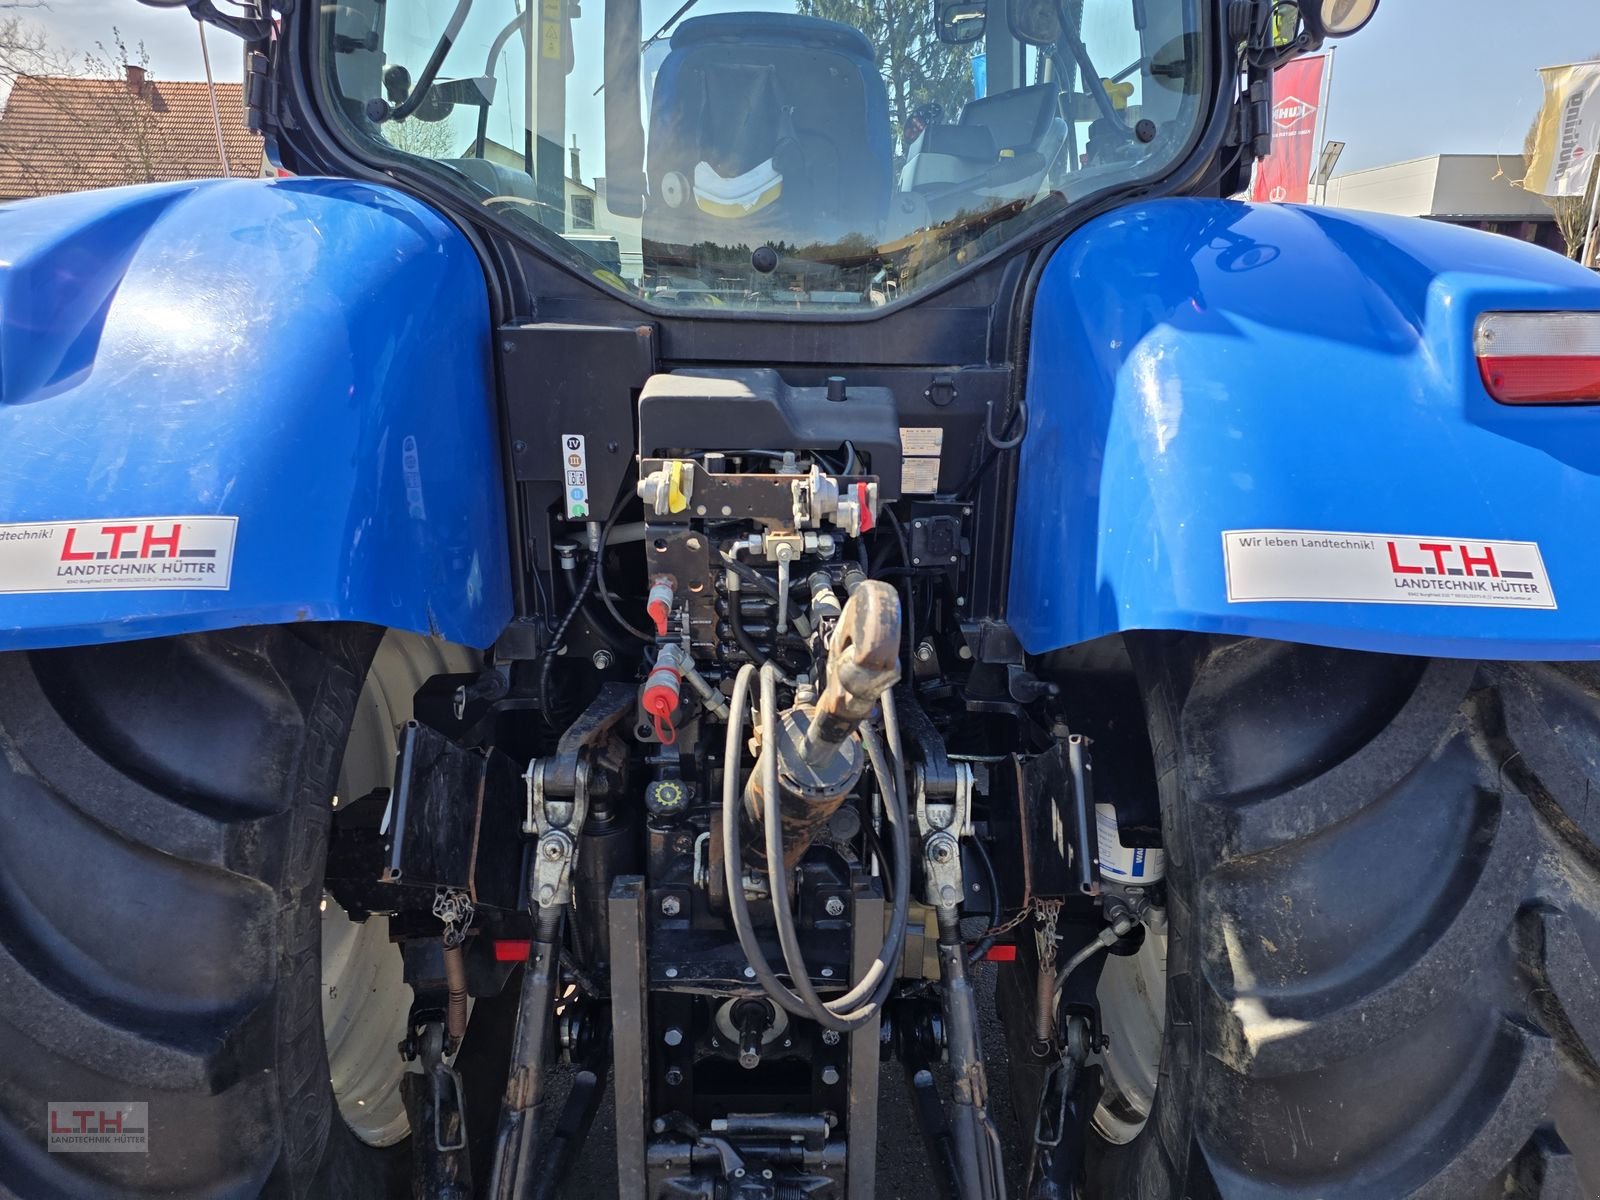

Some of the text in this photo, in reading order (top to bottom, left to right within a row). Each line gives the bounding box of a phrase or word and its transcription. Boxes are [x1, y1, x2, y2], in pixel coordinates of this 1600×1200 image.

[568, 440, 579, 448] IV
[570, 456, 580, 465] III
[1239, 536, 1375, 550] Wir leben Landtechnik!
[57, 559, 216, 577] LANDTECHNIK HÜTTER
[1394, 577, 1540, 594] LANDTECHNIK HÜTTER
